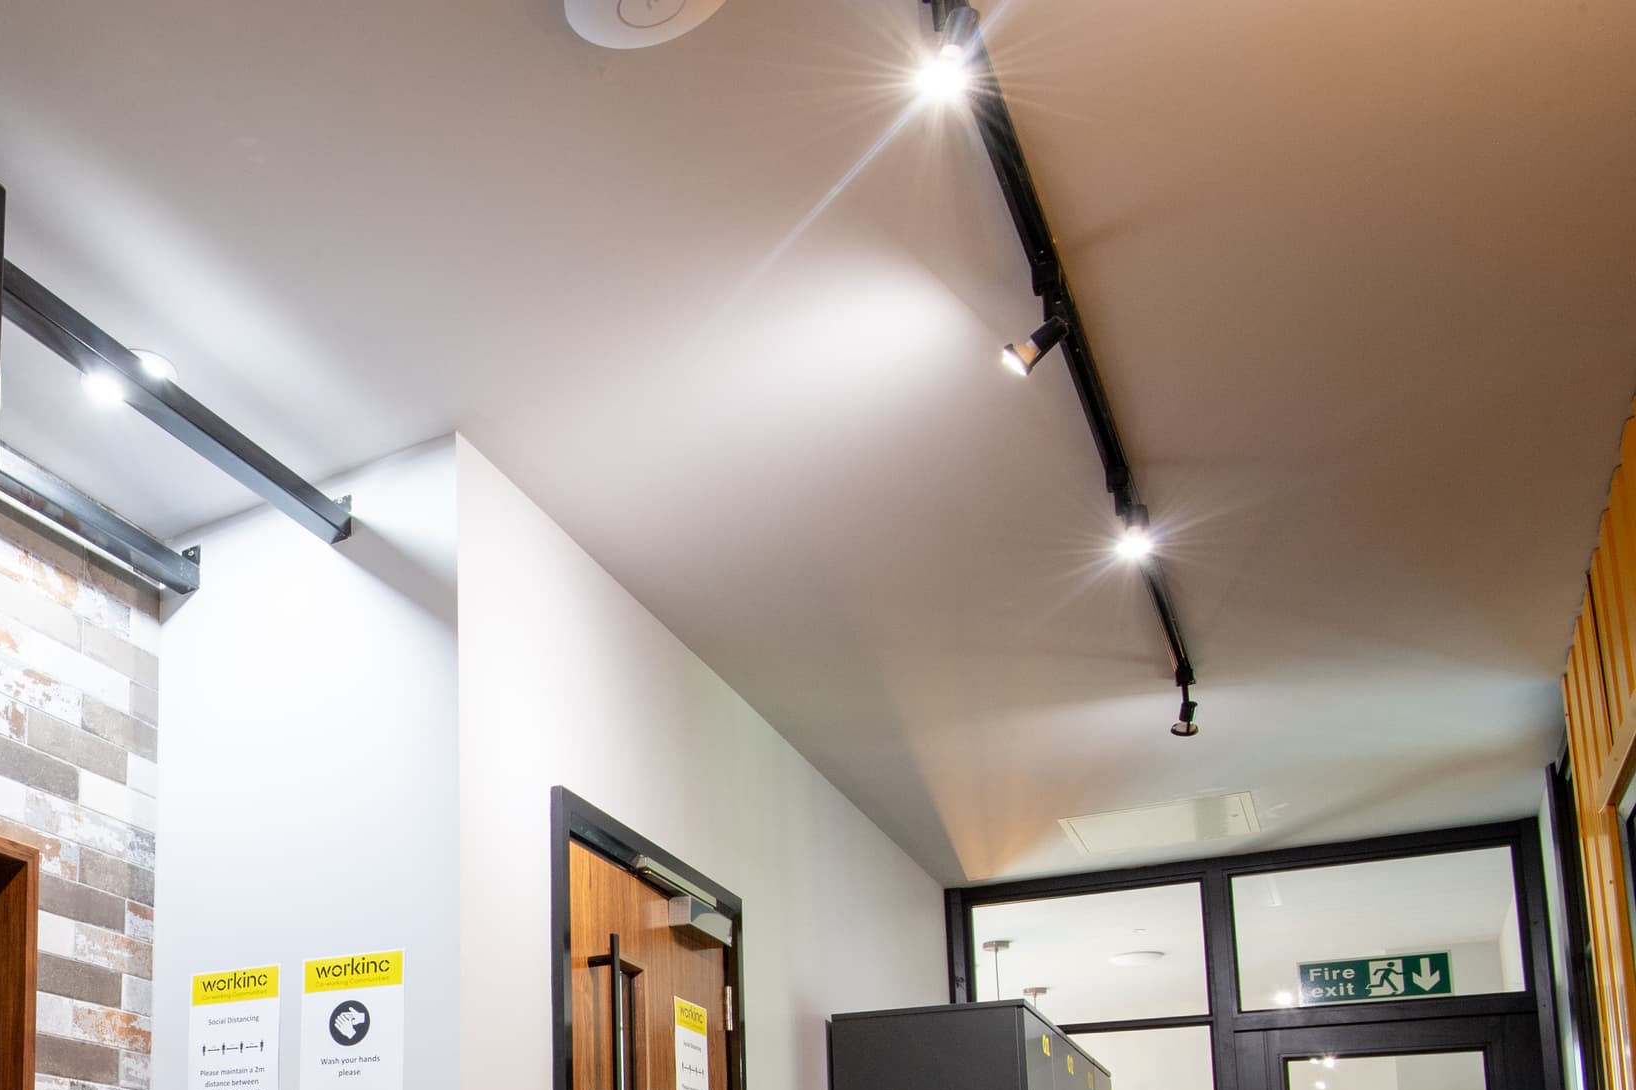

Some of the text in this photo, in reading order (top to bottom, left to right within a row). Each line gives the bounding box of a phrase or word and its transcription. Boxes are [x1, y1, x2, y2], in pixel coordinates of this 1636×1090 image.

[315, 956, 390, 979] workinc
[1308, 968, 1356, 982] Fire
[202, 971, 268, 992] workinc
[1310, 983, 1356, 998] exit
[207, 1014, 260, 1026] Social Distancing
[320, 1055, 381, 1066] Wash your hands
[200, 1069, 219, 1077] Please
[220, 1067, 248, 1075] maintain
[338, 1068, 361, 1077] please
[204, 1078, 259, 1088] distance between
